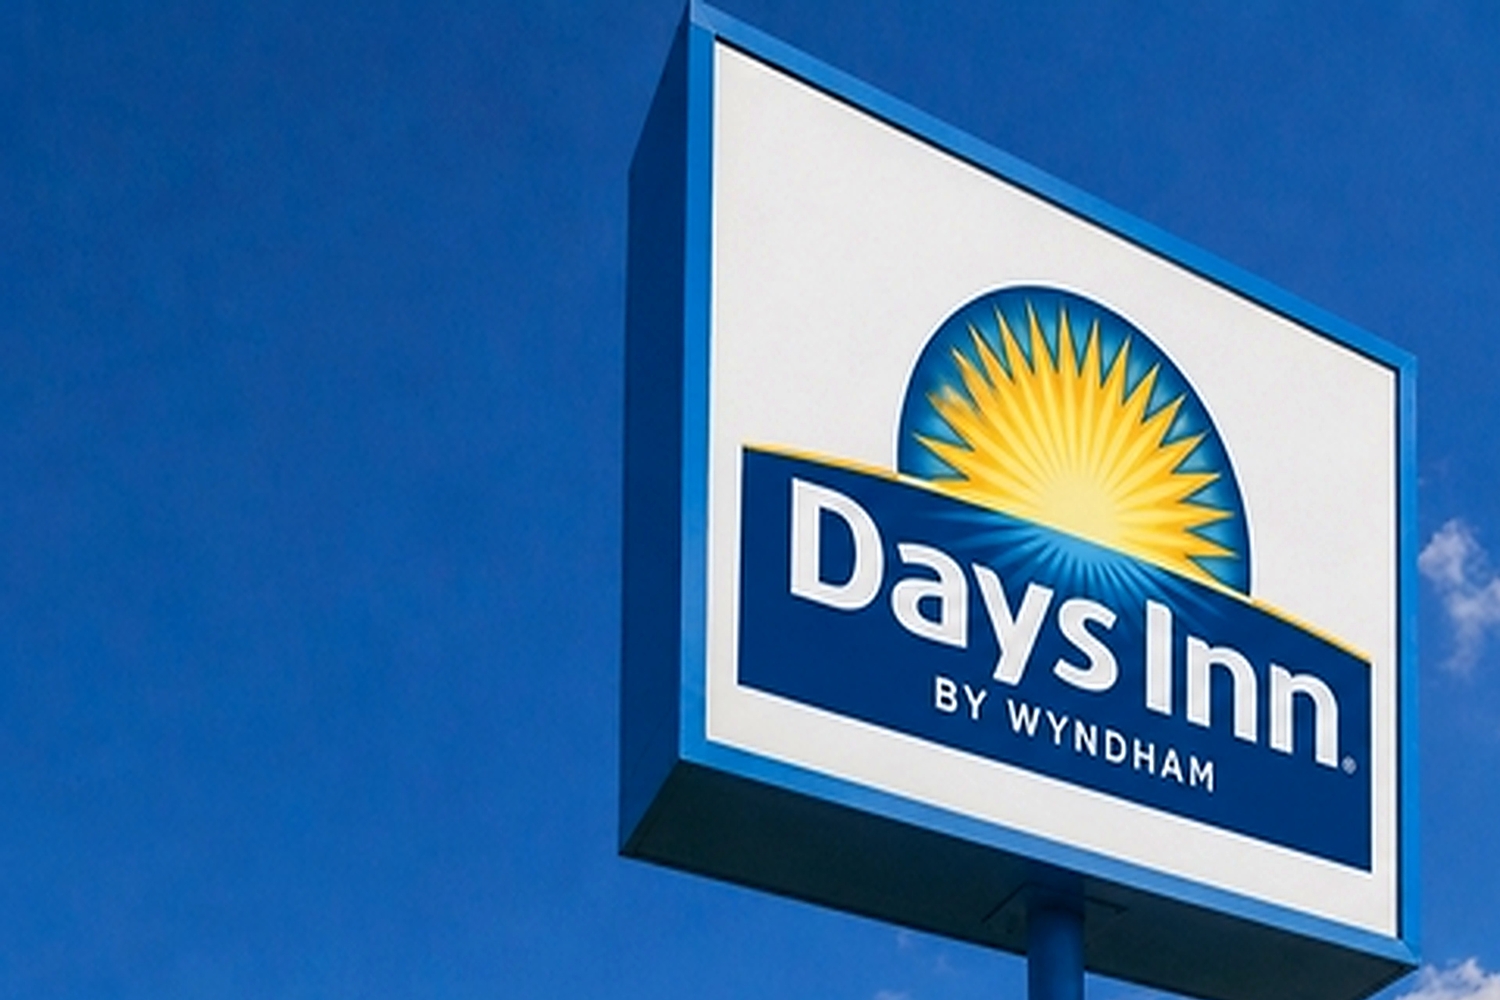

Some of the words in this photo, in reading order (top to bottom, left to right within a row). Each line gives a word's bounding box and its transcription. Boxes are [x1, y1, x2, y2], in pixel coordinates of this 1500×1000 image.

[790, 477, 1118, 692] Days
[1145, 599, 1339, 769] Inn
[935, 676, 987, 720] BY
[1007, 699, 1214, 792] WYNDHAM
